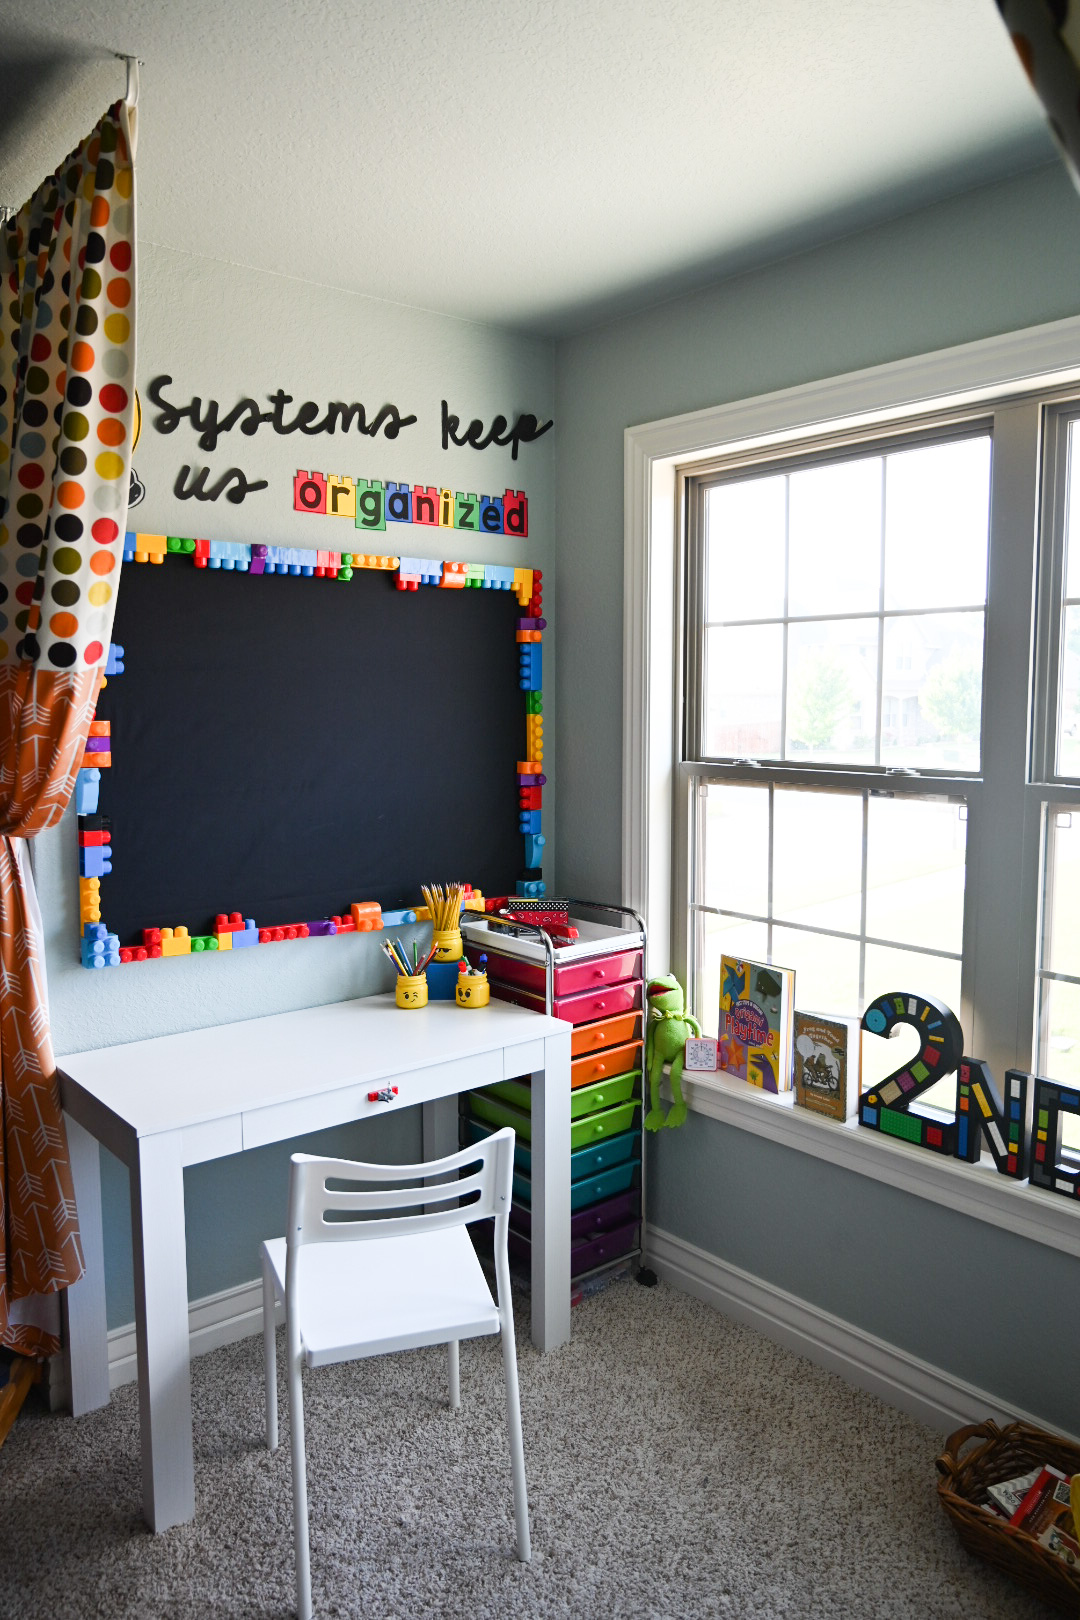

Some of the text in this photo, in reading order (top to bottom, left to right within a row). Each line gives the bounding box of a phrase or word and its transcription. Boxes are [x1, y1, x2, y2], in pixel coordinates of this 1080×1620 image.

[147, 374, 554, 460] Systems keep
[173, 464, 526, 535] us organized
[725, 1013, 774, 1048] Playtime
